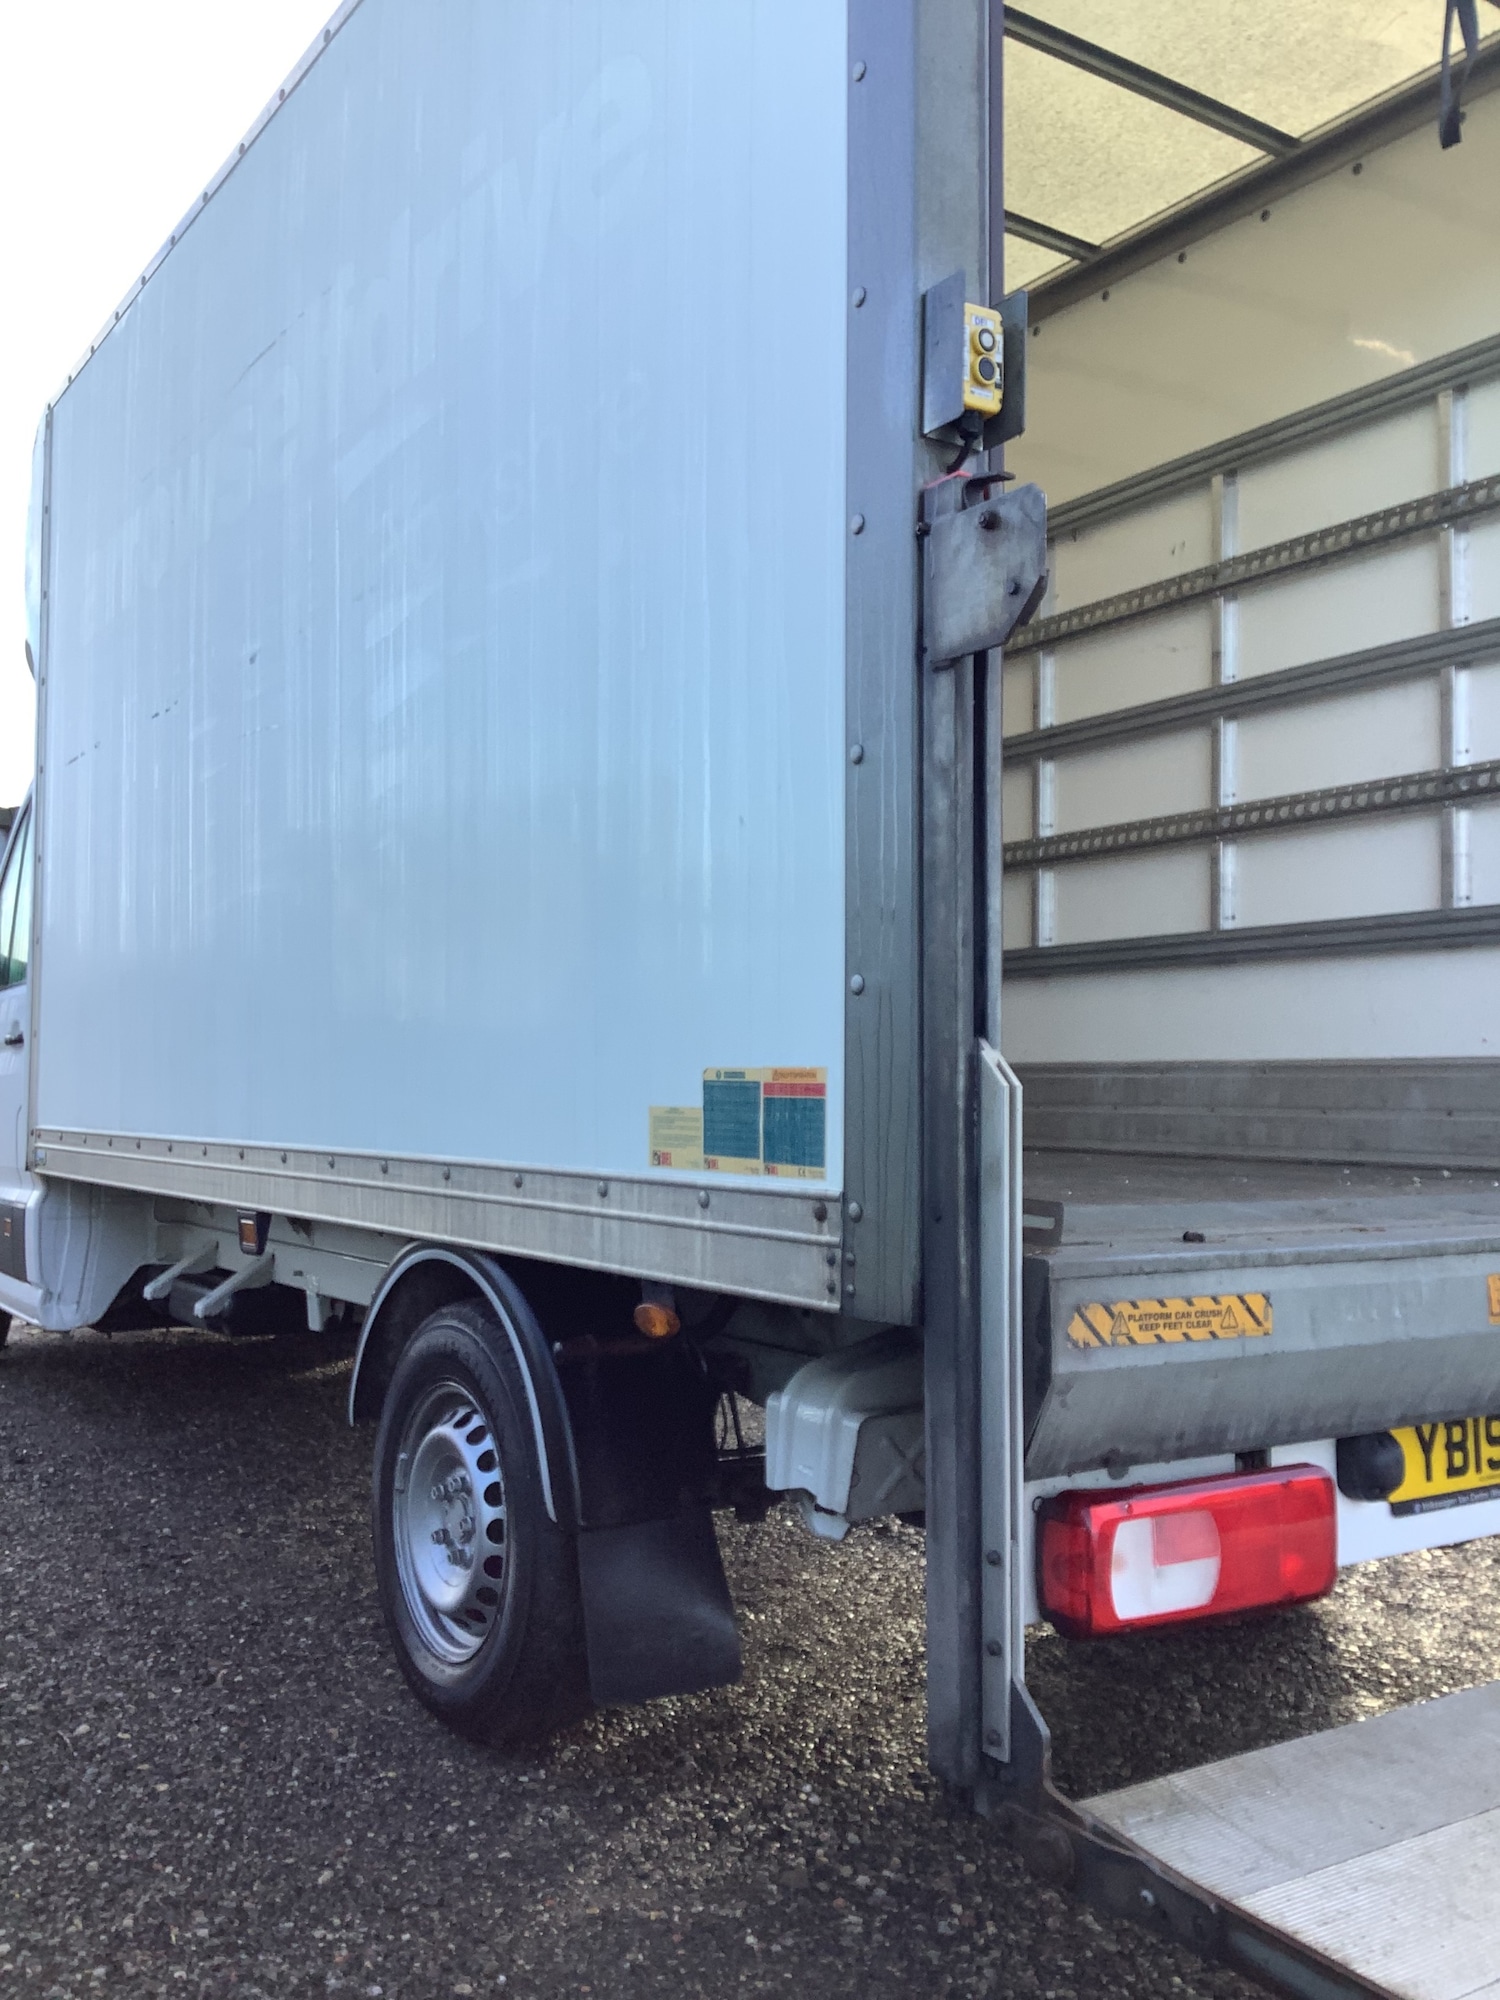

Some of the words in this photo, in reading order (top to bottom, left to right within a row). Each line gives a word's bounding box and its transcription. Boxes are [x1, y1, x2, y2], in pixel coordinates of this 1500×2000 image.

[1128, 1312, 1172, 1322] PLATFORM
[1175, 1311, 1193, 1320] CAN
[1194, 1309, 1223, 1318] CRUSH
[1139, 1322, 1161, 1332] KEEP
[1163, 1321, 1183, 1330] FEET
[1185, 1320, 1212, 1329] CLEAR
